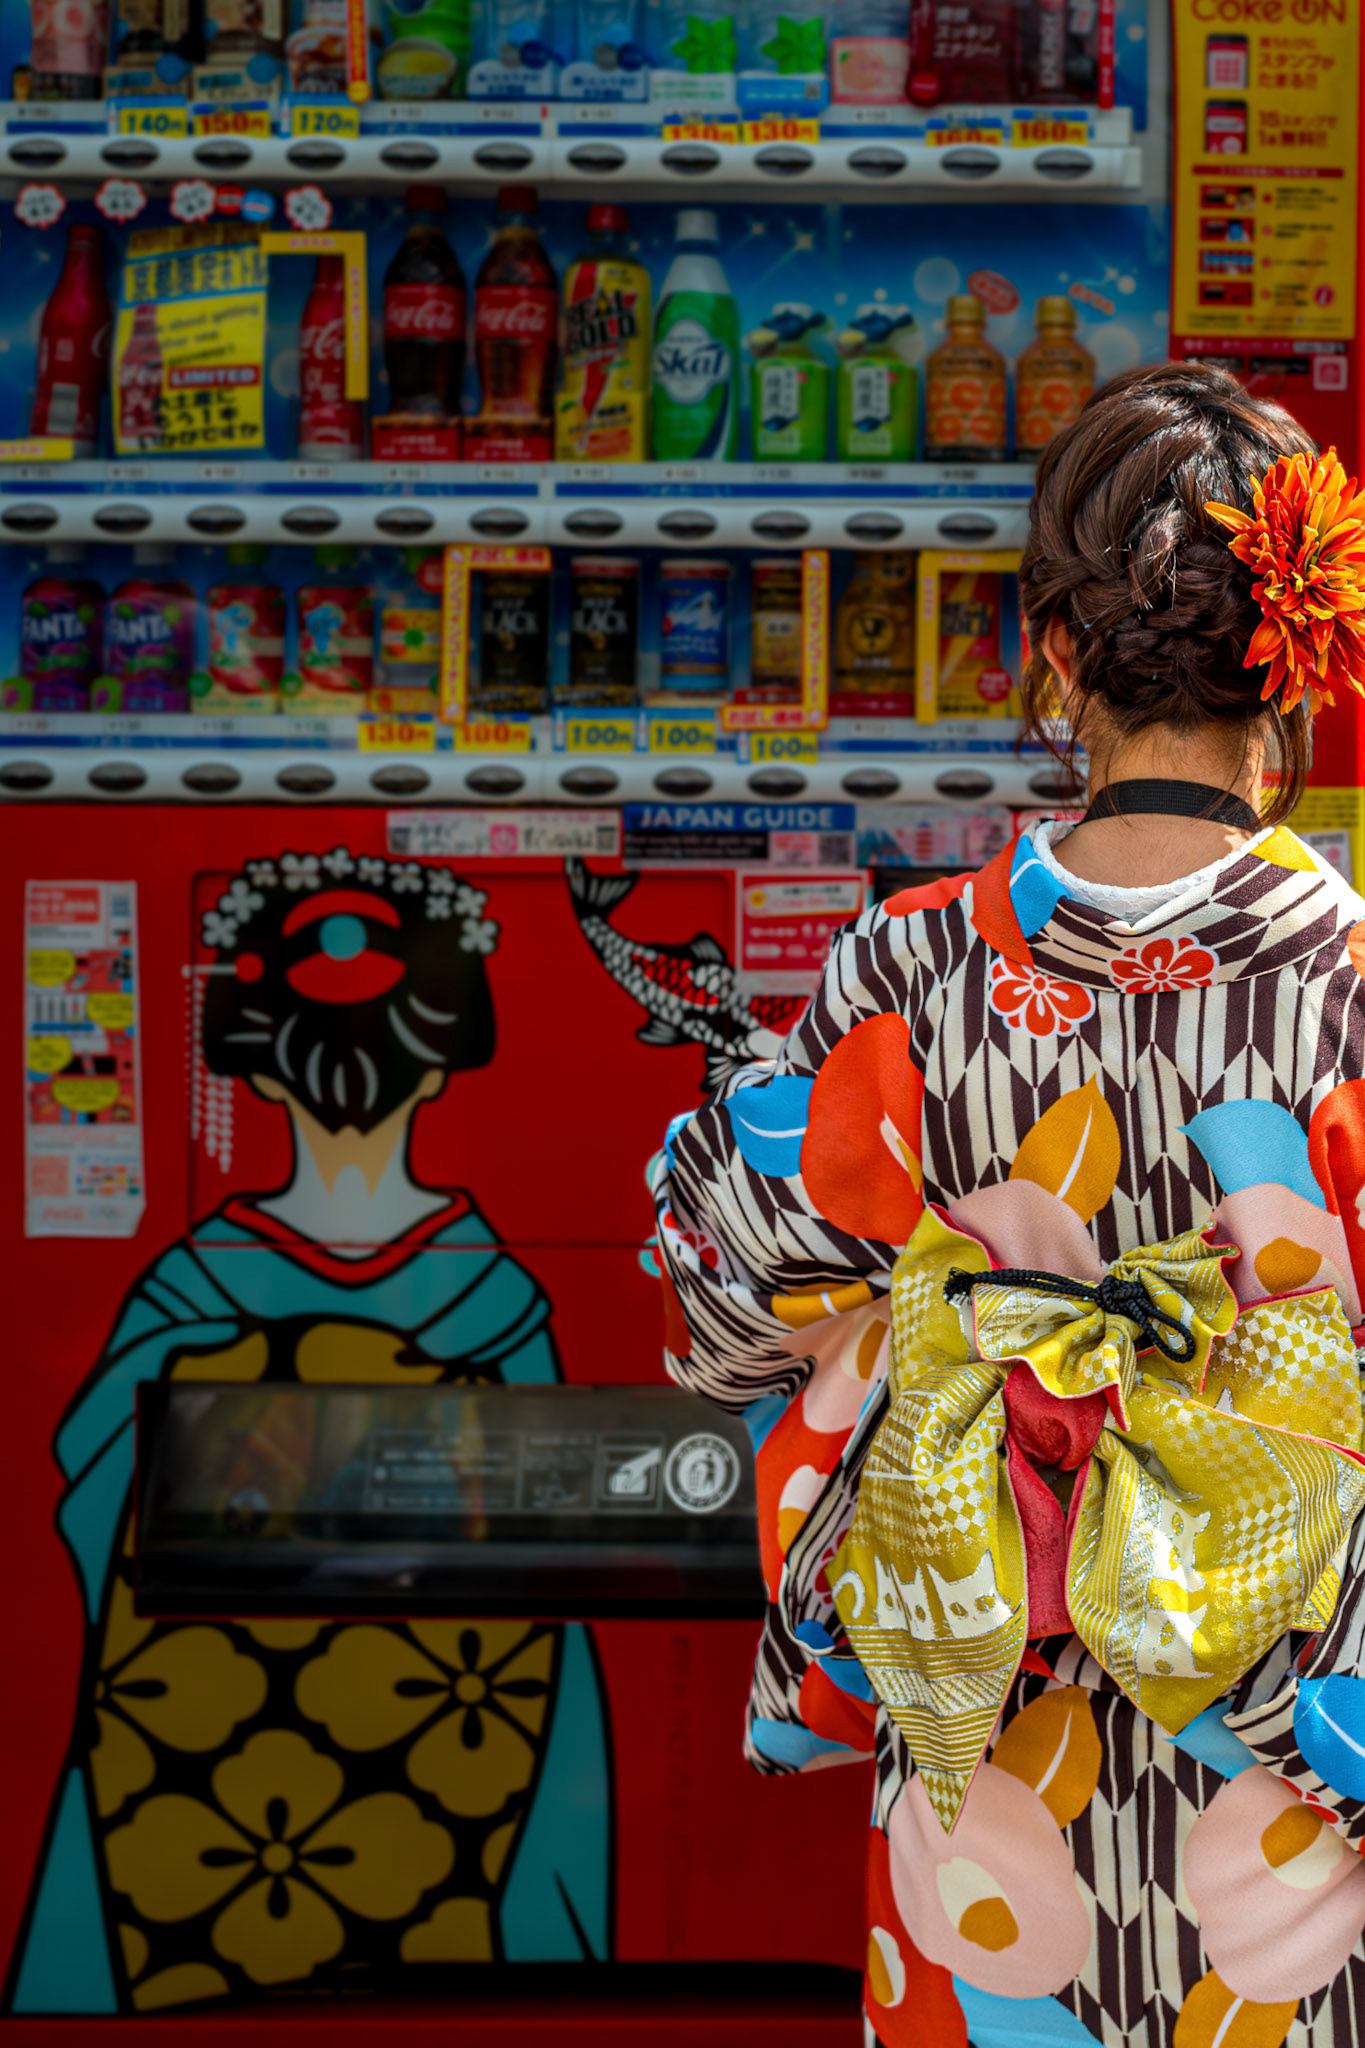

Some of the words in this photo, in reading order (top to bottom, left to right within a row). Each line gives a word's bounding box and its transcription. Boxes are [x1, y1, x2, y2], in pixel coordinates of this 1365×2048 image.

[1192, 0, 1282, 23] Coke
[170, 367, 256, 386] LIMITED
[572, 726, 631, 745] 100円
[655, 727, 714, 745] 100円
[757, 739, 816, 757] 100円
[640, 806, 735, 829] JAPAN
[743, 807, 834, 828] GUIDE
